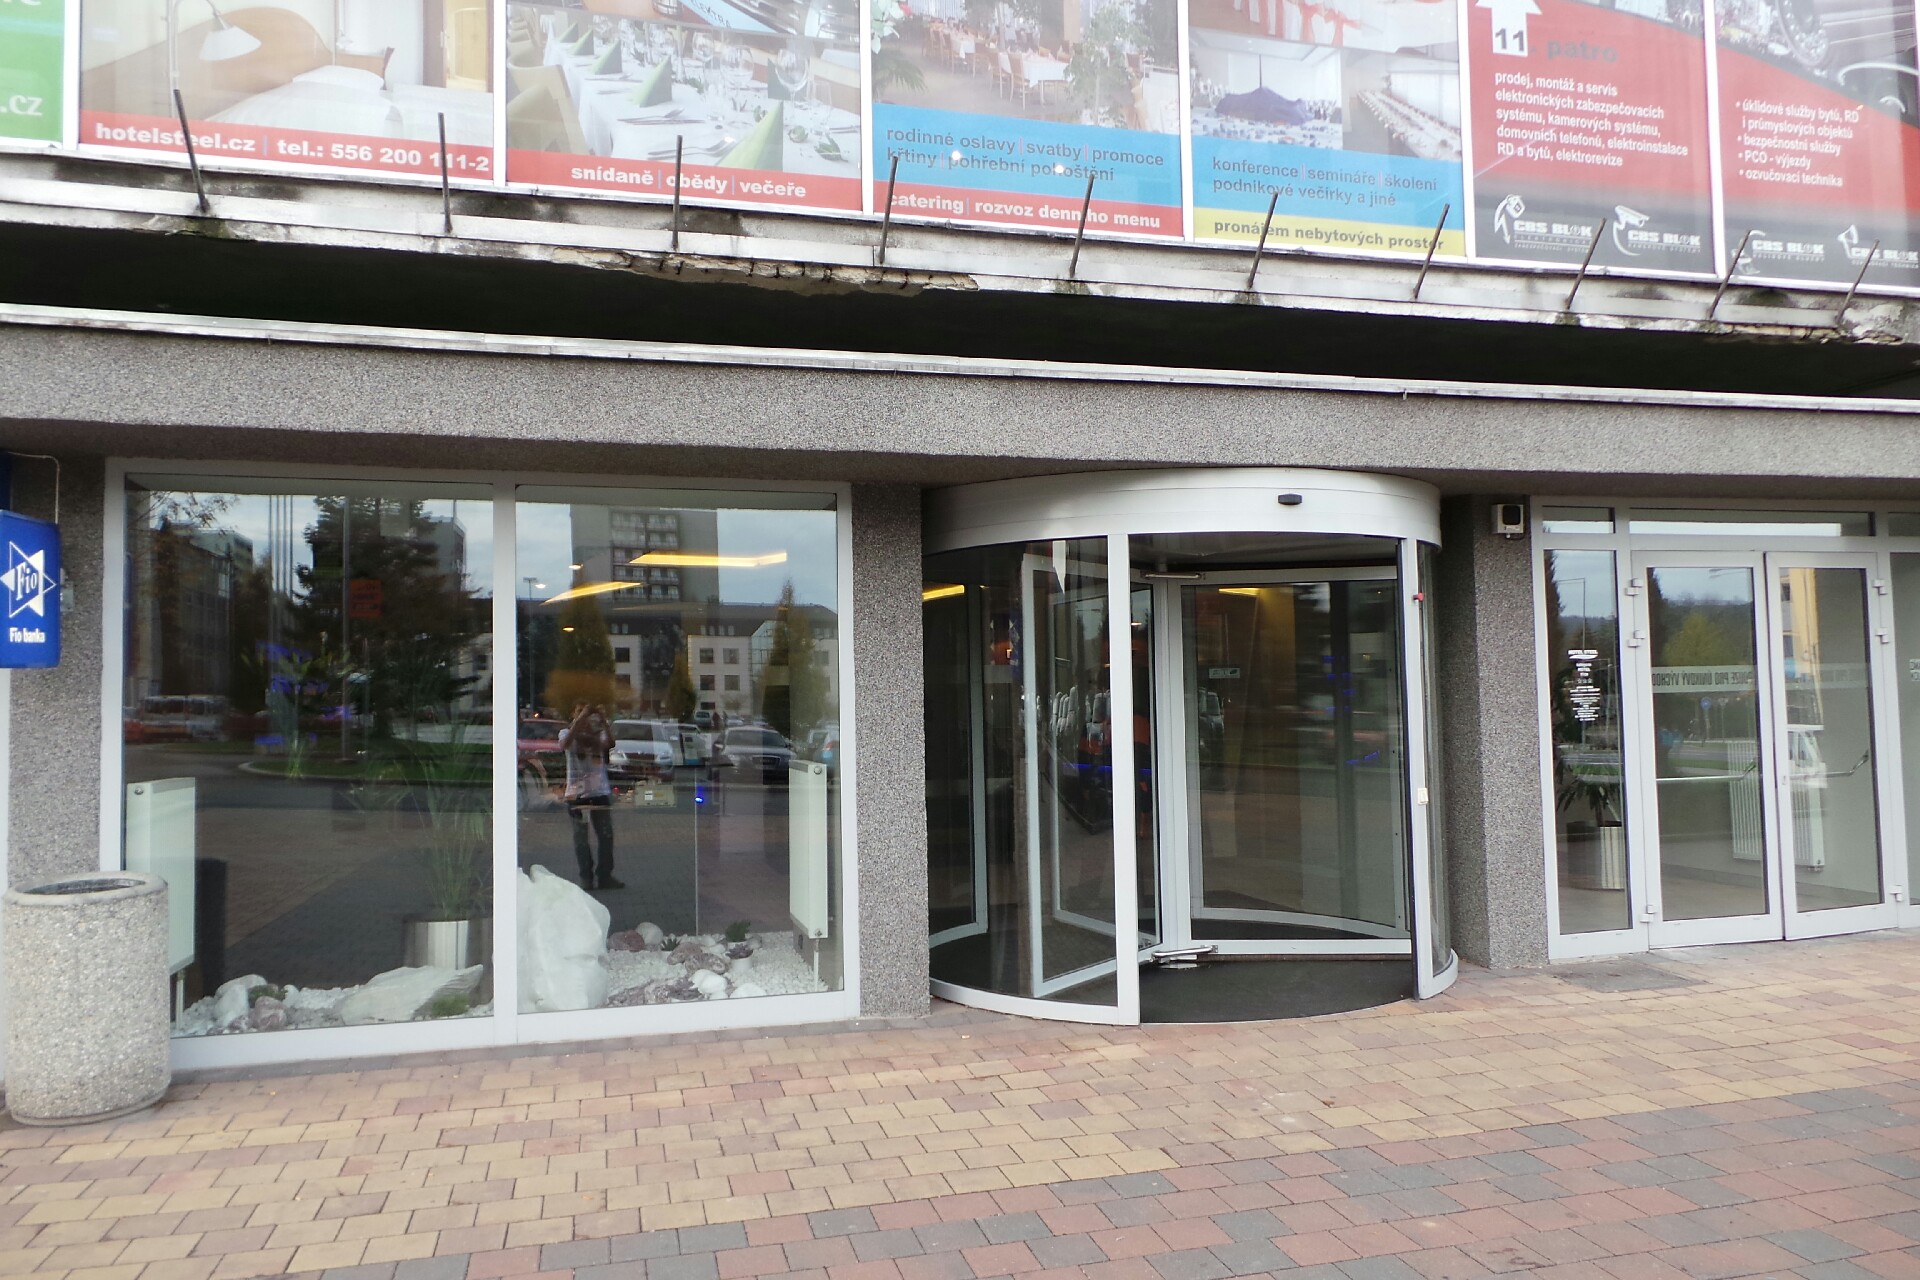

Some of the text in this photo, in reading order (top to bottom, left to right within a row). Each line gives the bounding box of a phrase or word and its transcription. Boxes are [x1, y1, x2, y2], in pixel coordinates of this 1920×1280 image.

[1546, 39, 1618, 63] patro
[1495, 72, 1618, 97] prodej, montáž a servis
[1495, 88, 1665, 119] elektronických zabezpečovacích
[1785, 104, 1816, 121] služby
[1844, 109, 1859, 123] RD
[1548, 112, 1612, 133] kamerových
[95, 122, 256, 152] hotelsteel.cz
[277, 139, 323, 157] tel.:
[331, 143, 373, 161] 556
[380, 147, 422, 165] 200
[887, 128, 1164, 166] rodinné oslavy svatby promoce
[1496, 124, 1689, 156] domovních telefonů, elektroinstalace
[1809, 140, 1841, 157] služby
[888, 147, 937, 168] křtiny
[948, 154, 1025, 173] pohřební
[1497, 142, 1514, 156] RD
[1517, 147, 1524, 157] a
[1555, 148, 1624, 167] elektrorevize
[1744, 149, 1768, 164] PCO
[571, 166, 807, 197] snídaně obědy večeře
[1212, 157, 1437, 191] konference semináře školení
[1802, 172, 1844, 187] technika
[1213, 179, 1294, 196] podnikové
[1357, 193, 1365, 203] a
[1369, 191, 1396, 208] jiné
[975, 201, 1034, 217] rozvoz
[1038, 205, 1109, 223] dennho
[1113, 213, 1161, 228] menu
[1513, 220, 1548, 233] CBS
[1295, 227, 1384, 246] nebytových
[16, 561, 39, 601] Fio
[9, 627, 46, 643] Fio banka
